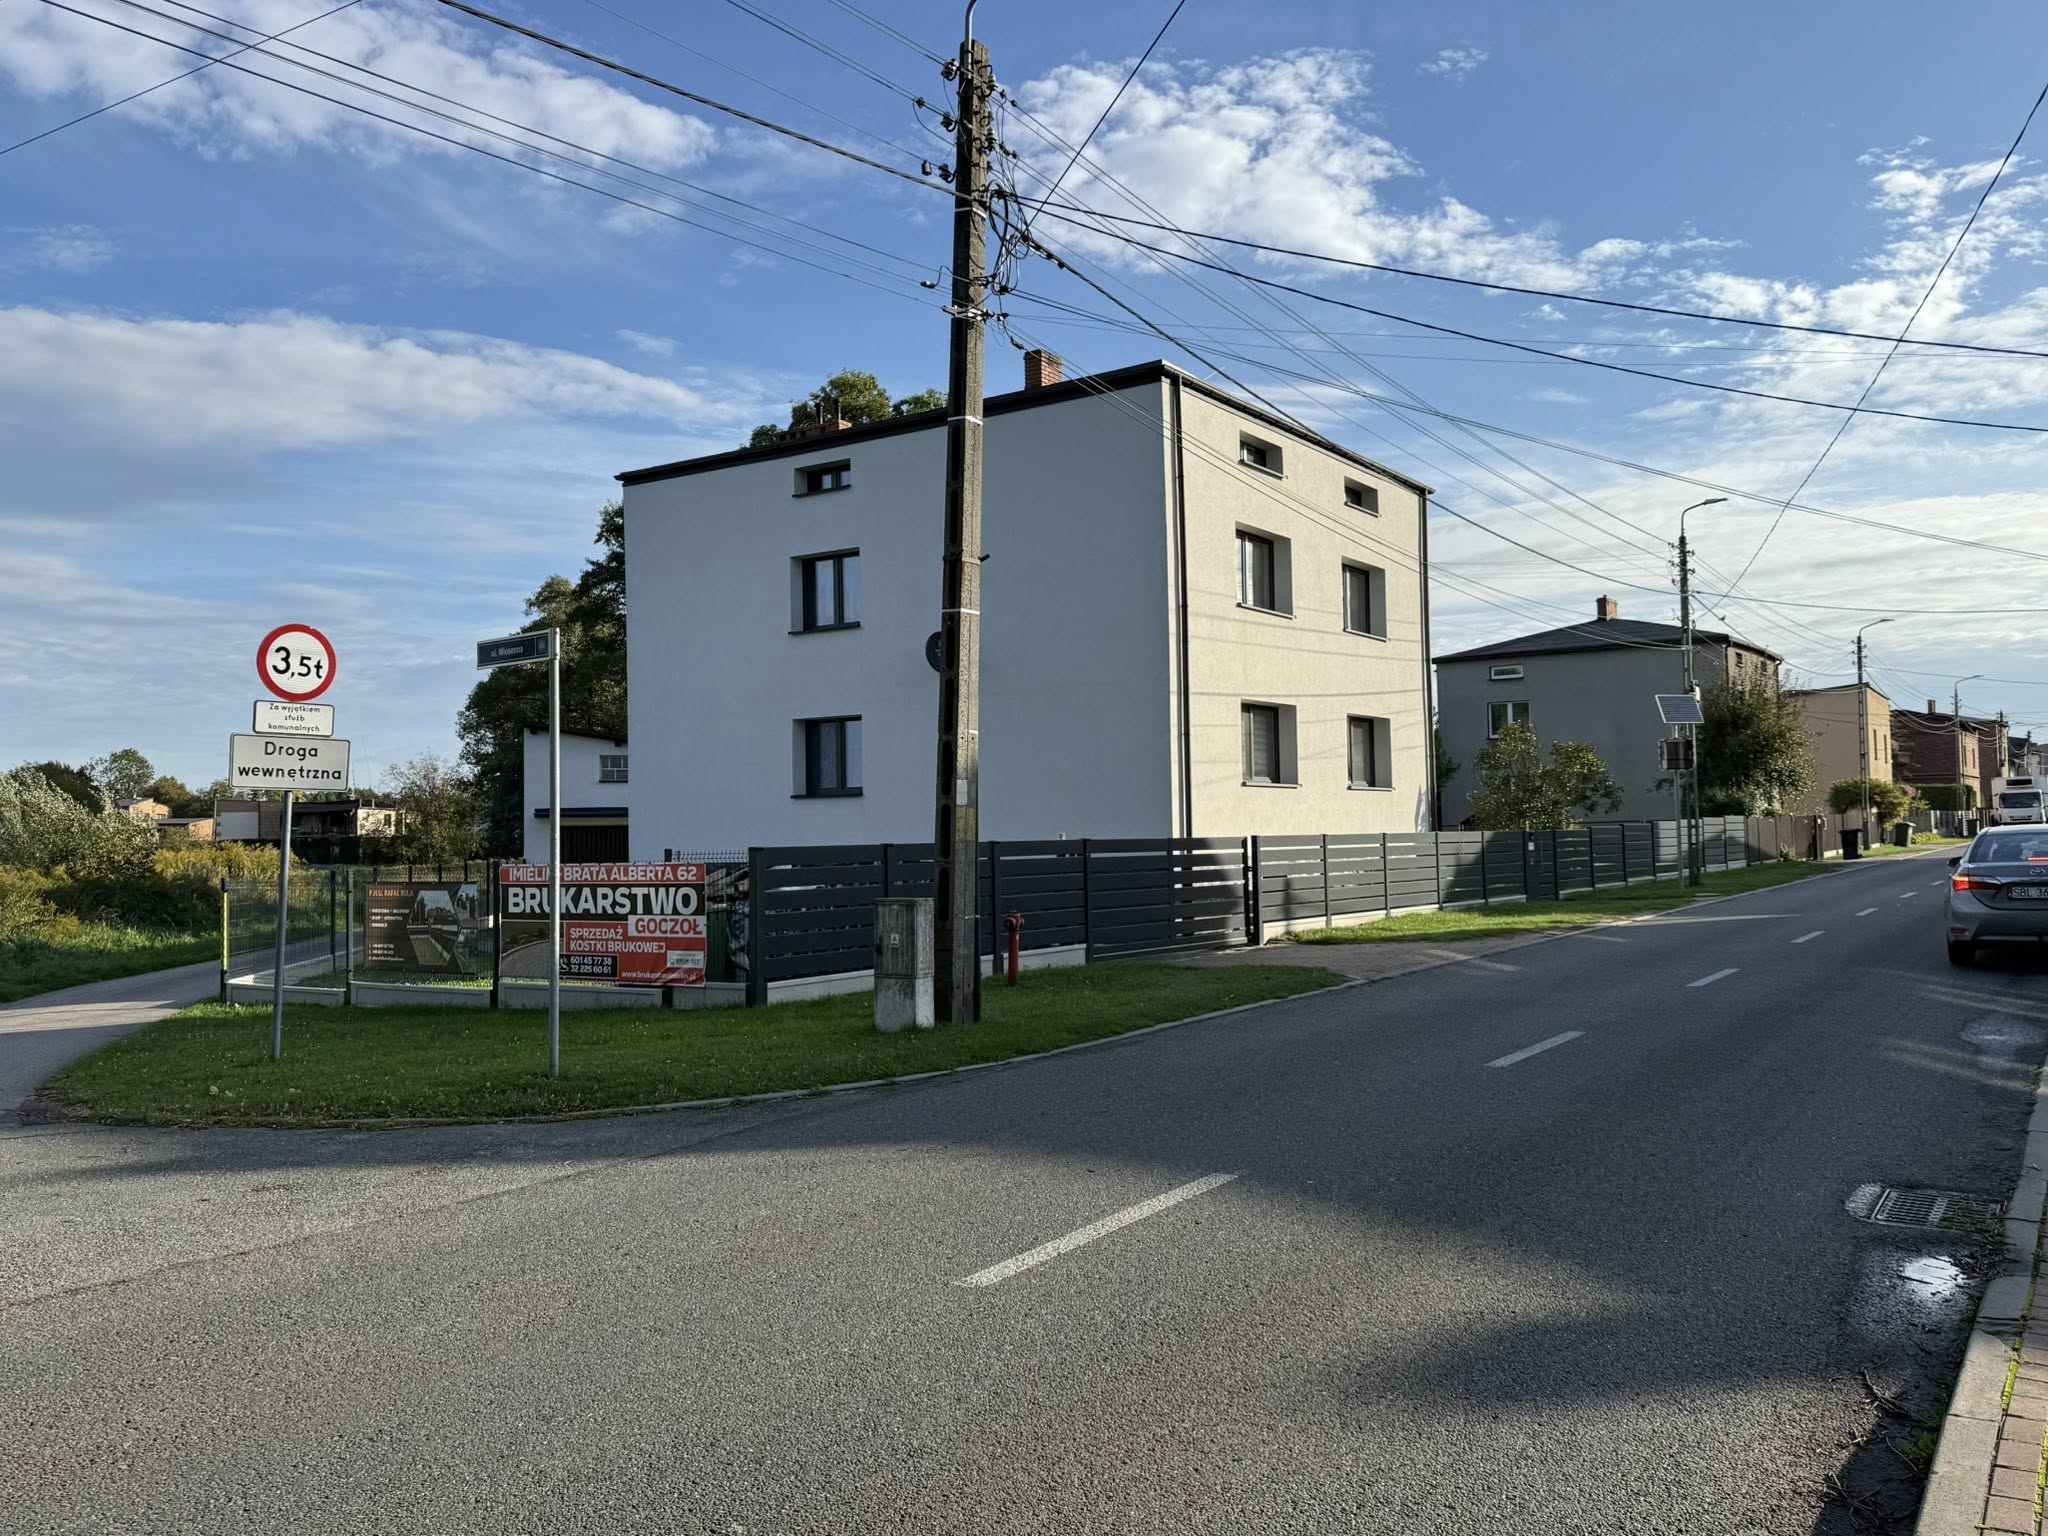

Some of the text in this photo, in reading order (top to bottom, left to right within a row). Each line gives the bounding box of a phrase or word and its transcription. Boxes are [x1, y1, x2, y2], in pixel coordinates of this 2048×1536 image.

[272, 646, 323, 679] 3,5t
[281, 705, 320, 713] wyjątkiem
[268, 722, 320, 733] komunalnych
[264, 741, 318, 761] Droga
[238, 765, 342, 782] wewnętrzna
[564, 866, 608, 881] BRATA
[610, 866, 674, 881] ALBERTA
[677, 866, 697, 881] 62
[570, 925, 623, 939] SPRZEDAŻ
[635, 918, 703, 935] GOCZOŁ
[570, 940, 666, 953] KOSTKI BRUKOWEJ
[593, 957, 602, 965] 77
